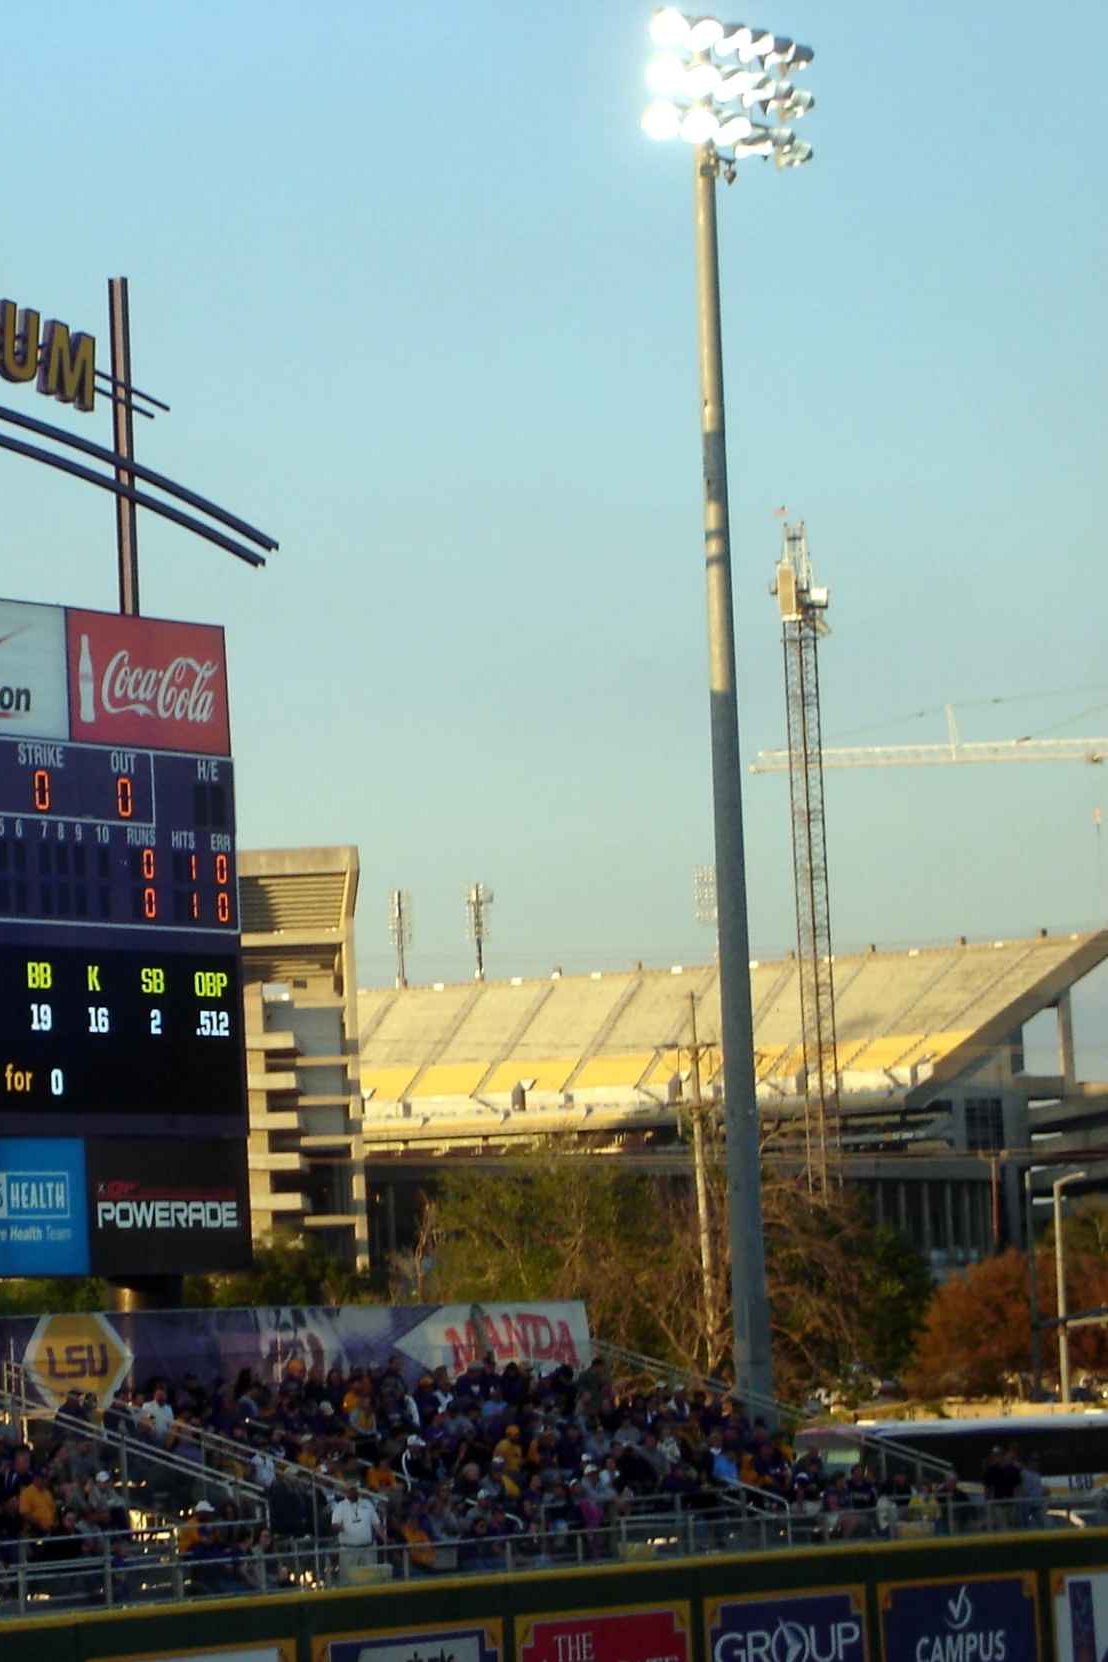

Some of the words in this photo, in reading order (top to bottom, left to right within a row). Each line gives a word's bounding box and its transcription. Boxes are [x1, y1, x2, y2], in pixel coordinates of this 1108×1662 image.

[18, 744, 64, 768] STRIKE
[110, 752, 136, 774] OUT
[198, 761, 219, 782] H/E
[34, 770, 50, 811] 0
[117, 777, 132, 818] 0
[15, 819, 23, 838] 6
[41, 821, 48, 838] 7
[57, 822, 65, 840] 8
[75, 824, 83, 842] 9
[96, 825, 110, 844] 10
[127, 826, 156, 847] RUNS
[172, 830, 195, 849] HITS
[211, 833, 231, 852] ERR
[143, 849, 155, 880] 0
[216, 854, 228, 885] 0
[144, 888, 157, 919] 0
[218, 892, 229, 923] 0
[27, 962, 52, 990] BB
[88, 965, 101, 992] K
[141, 968, 165, 994] SB
[195, 972, 228, 998] OBP
[30, 1004, 52, 1031] 19
[88, 1006, 109, 1034] 16
[150, 1009, 162, 1035] 2
[196, 1011, 230, 1037] .512
[5, 1063, 33, 1093] for
[51, 1068, 64, 1096] 0
[11, 1182, 65, 1209] HEALTH
[97, 1201, 238, 1229] POWERADE
[9, 1225, 42, 1241] Health
[46, 1225, 72, 1240] Team
[46, 1343, 109, 1379] LSU
[554, 1632, 595, 1661] THE
[714, 1617, 860, 1662] GROUP
[916, 1629, 1006, 1662] CAMPUS
